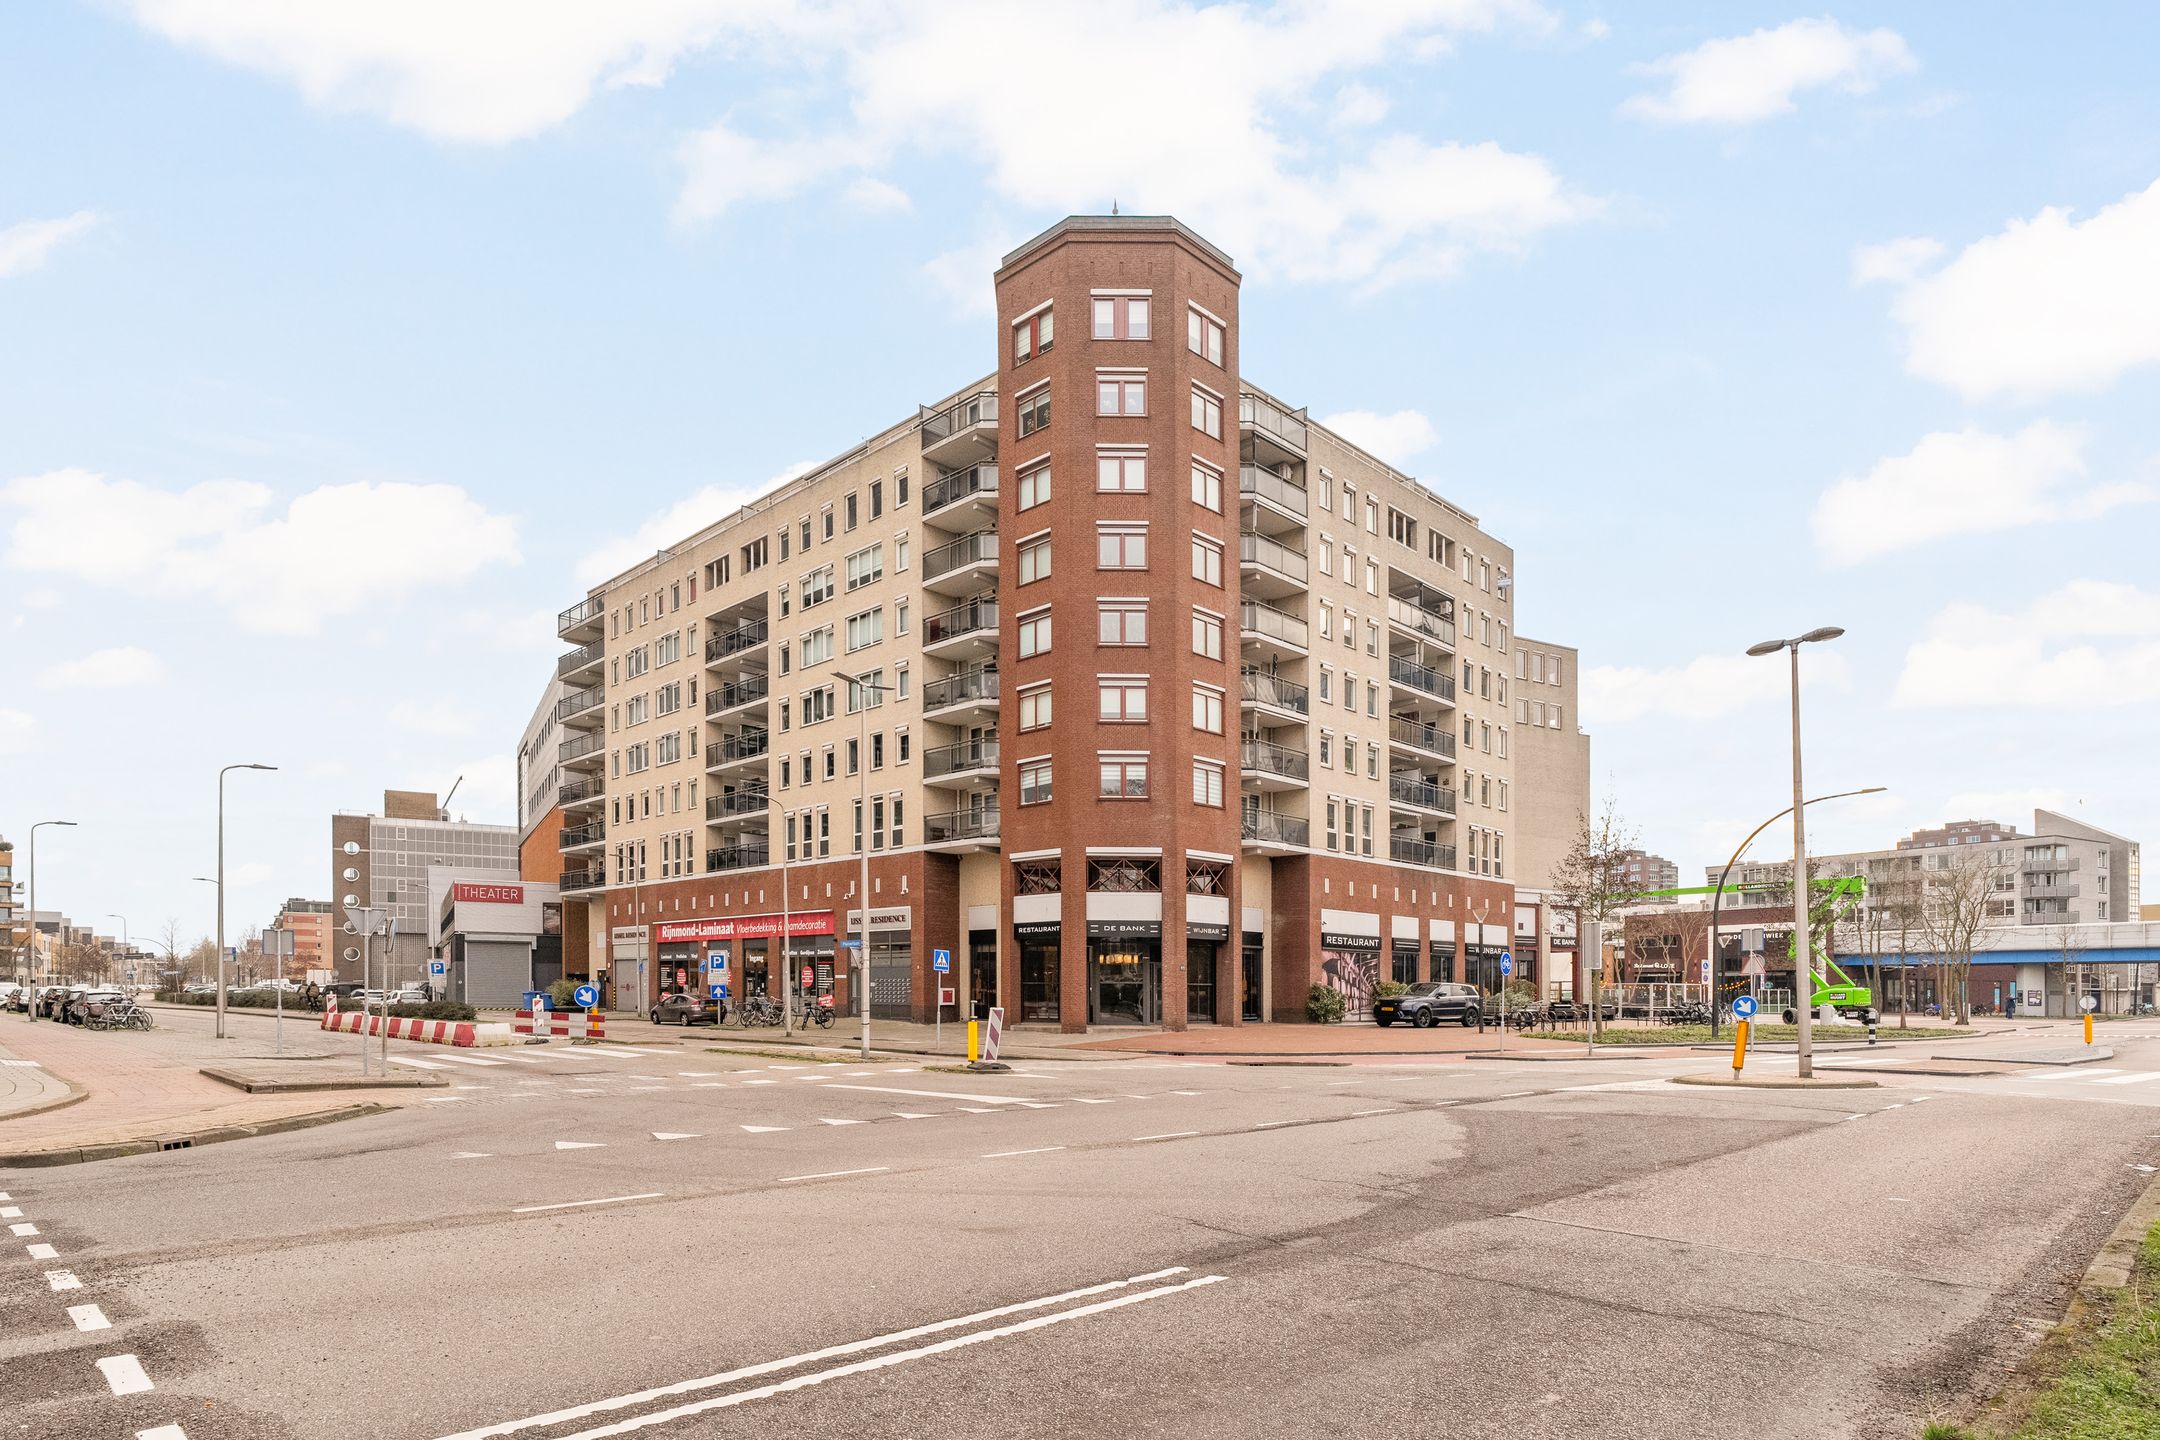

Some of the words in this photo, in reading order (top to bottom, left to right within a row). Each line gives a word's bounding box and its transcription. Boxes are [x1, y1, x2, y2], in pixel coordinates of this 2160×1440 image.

[463, 887, 518, 900] THEATER
[870, 915, 906, 924] RESIDENCE
[662, 922, 734, 940] Rijnmond-Laminaat
[736, 922, 777, 933] Vloerbedekking
[778, 922, 782, 931] &
[1326, 936, 1379, 947] RESTAURANT
[1474, 947, 1502, 955] WJNBAR
